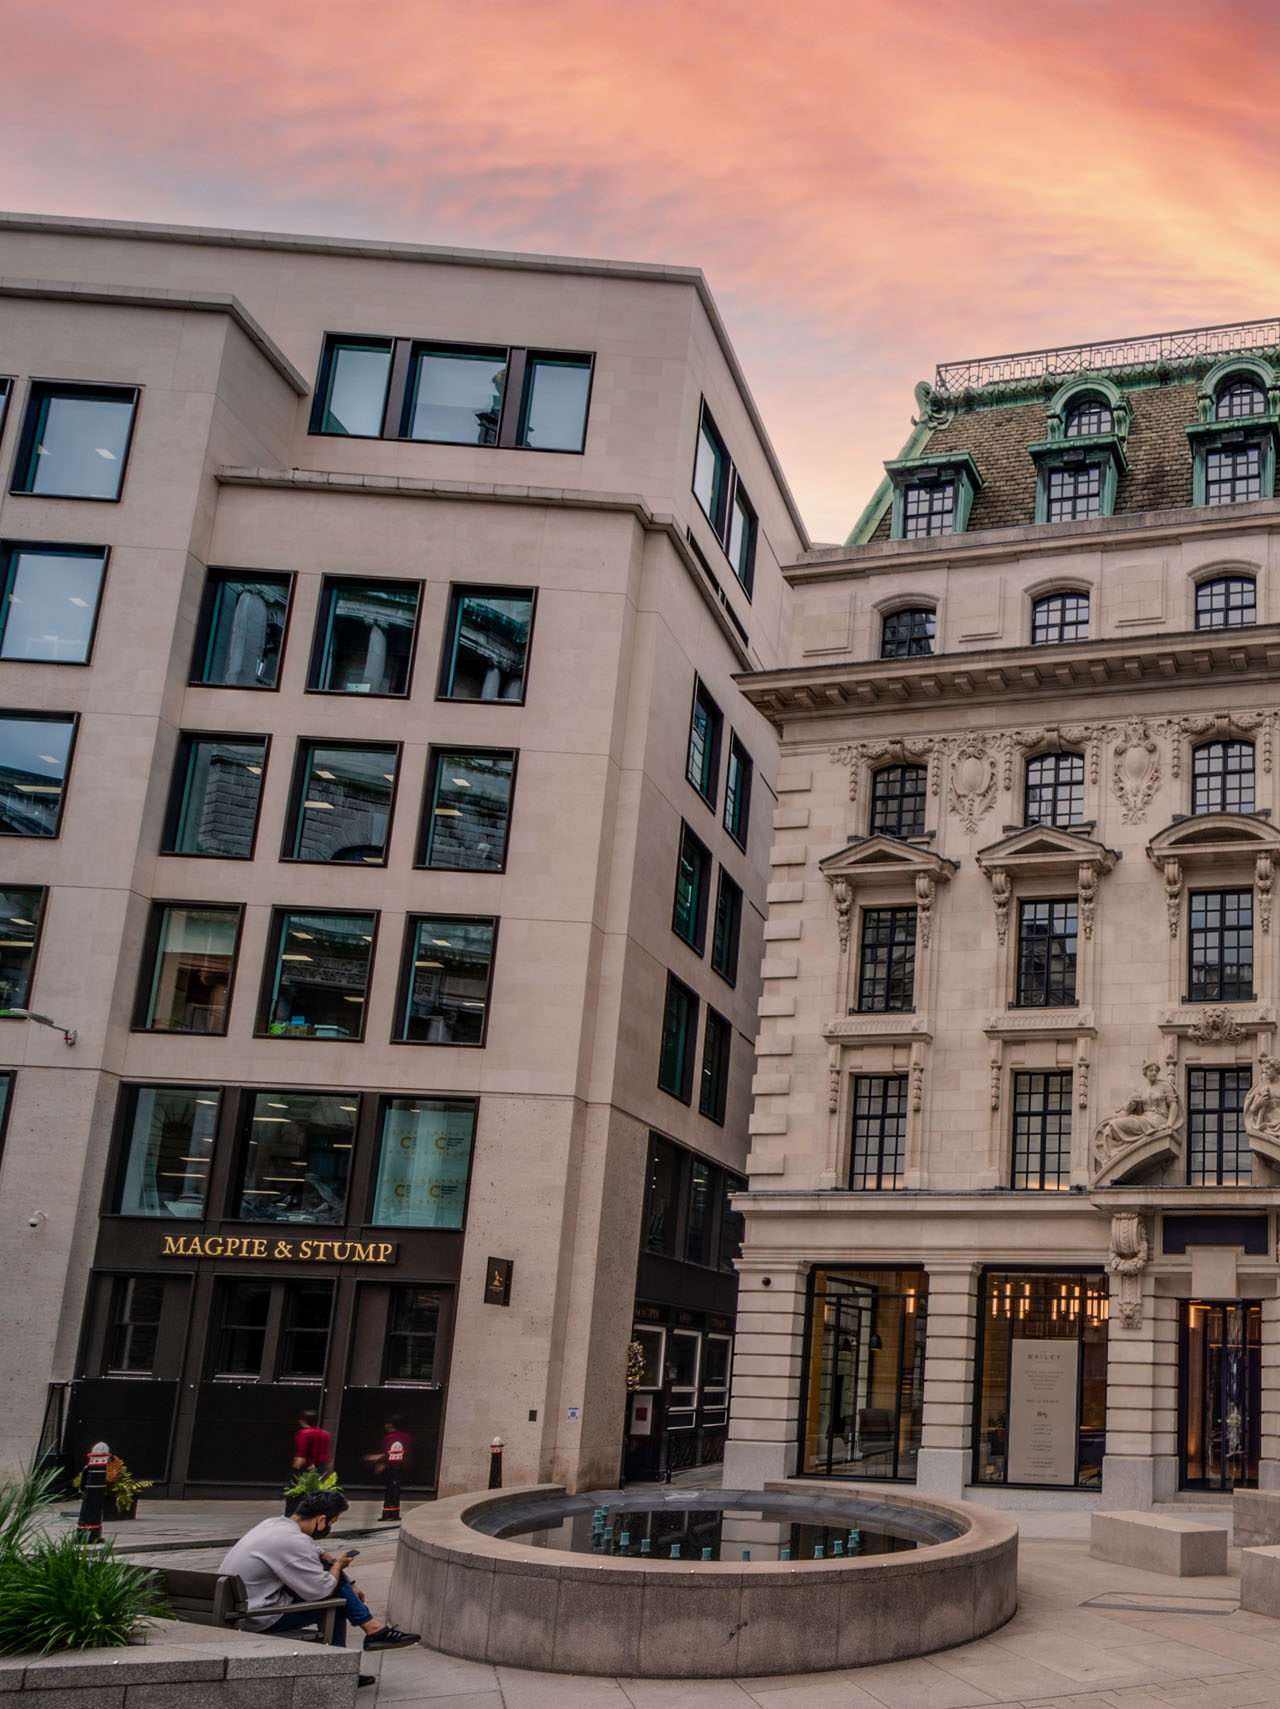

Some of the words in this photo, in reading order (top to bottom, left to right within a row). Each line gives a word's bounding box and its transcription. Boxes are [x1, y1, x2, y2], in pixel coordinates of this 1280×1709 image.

[162, 1236, 268, 1257] MAGPIE
[274, 1240, 292, 1259] &
[299, 1240, 393, 1262] STUMP
